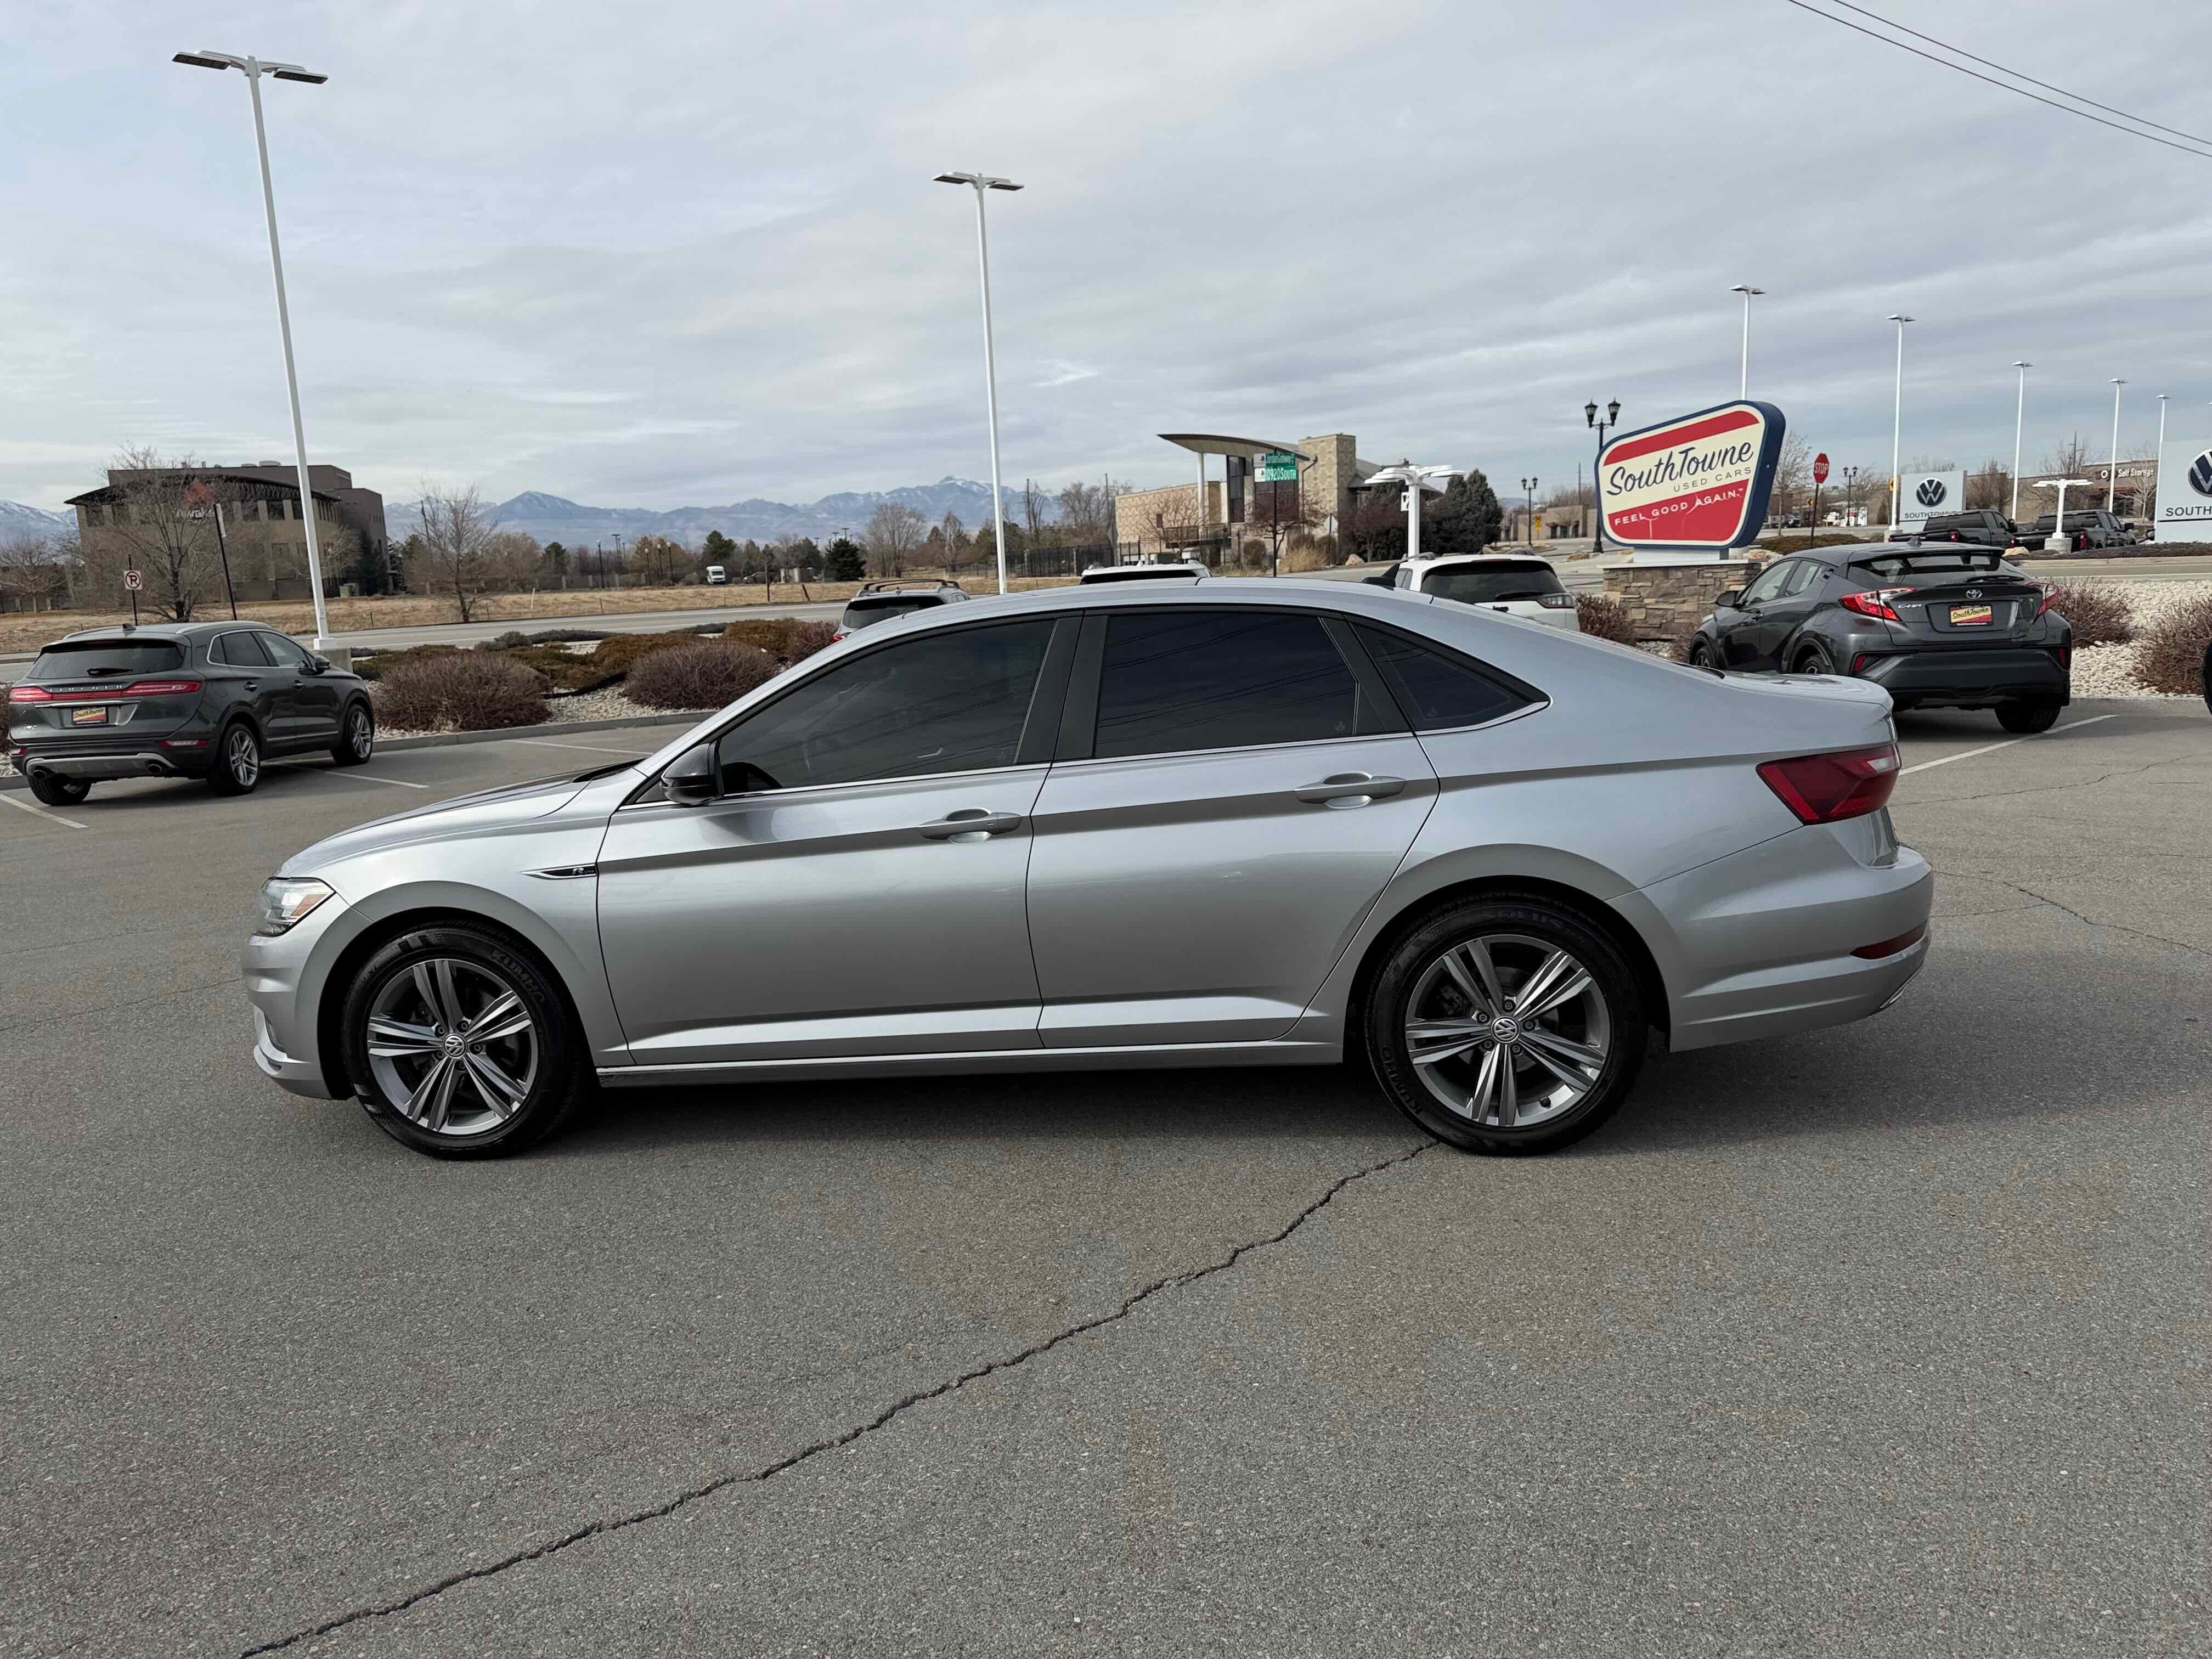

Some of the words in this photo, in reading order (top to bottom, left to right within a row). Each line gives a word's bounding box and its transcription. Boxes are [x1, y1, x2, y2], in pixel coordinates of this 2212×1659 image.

[1606, 442, 1754, 495] SouthTowne
[1814, 462, 1829, 474] STOP
[2118, 469, 2130, 478] Self
[2130, 468, 2154, 477] Storage
[1673, 478, 1707, 492] USED
[1716, 467, 1752, 481] CARS
[1615, 512, 1645, 526] FEEL
[1651, 502, 1688, 517] GOOD
[2166, 505, 2212, 517] SOUTH
